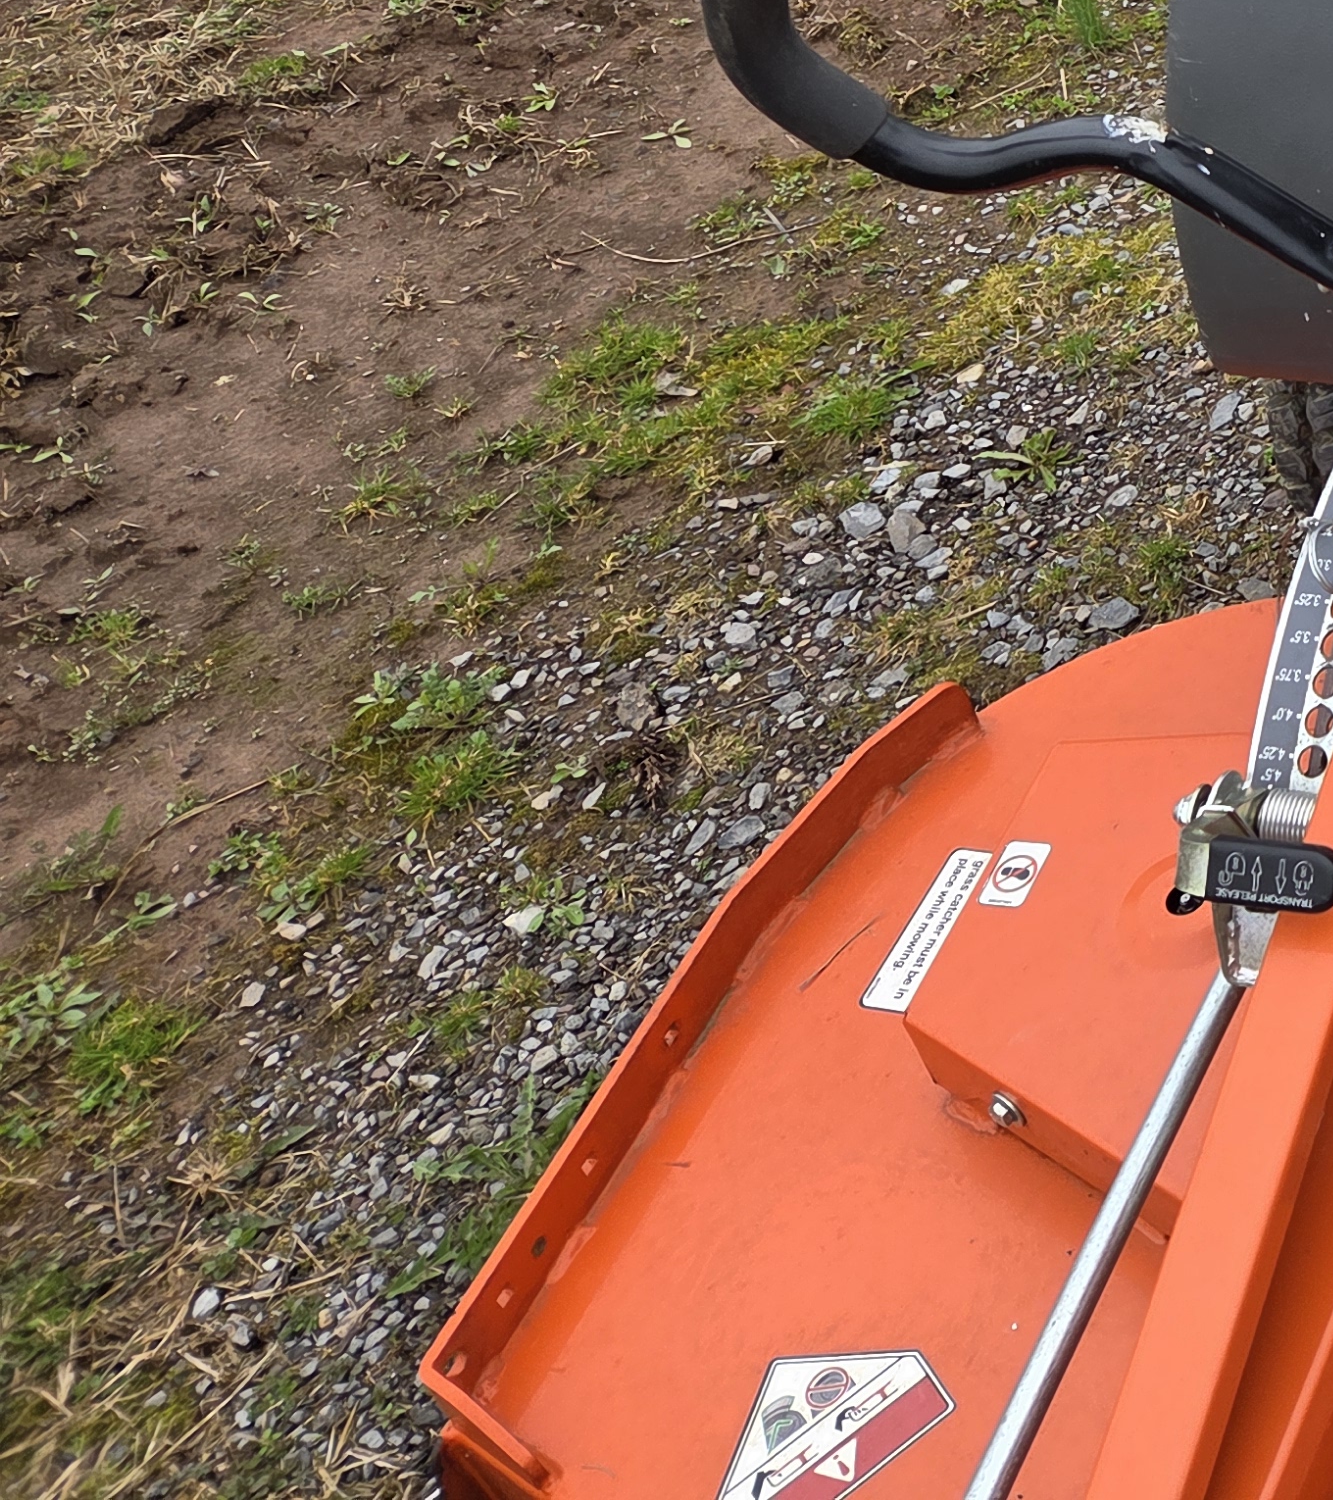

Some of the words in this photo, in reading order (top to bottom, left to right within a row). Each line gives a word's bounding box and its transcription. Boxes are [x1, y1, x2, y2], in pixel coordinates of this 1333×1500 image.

[944, 857, 968, 888] place
[959, 860, 984, 891] grass
[924, 890, 948, 920] while
[932, 893, 963, 936] catcher
[892, 922, 928, 971] mowing.
[912, 938, 936, 967] must
[902, 970, 919, 985] be
[893, 987, 908, 999] in
